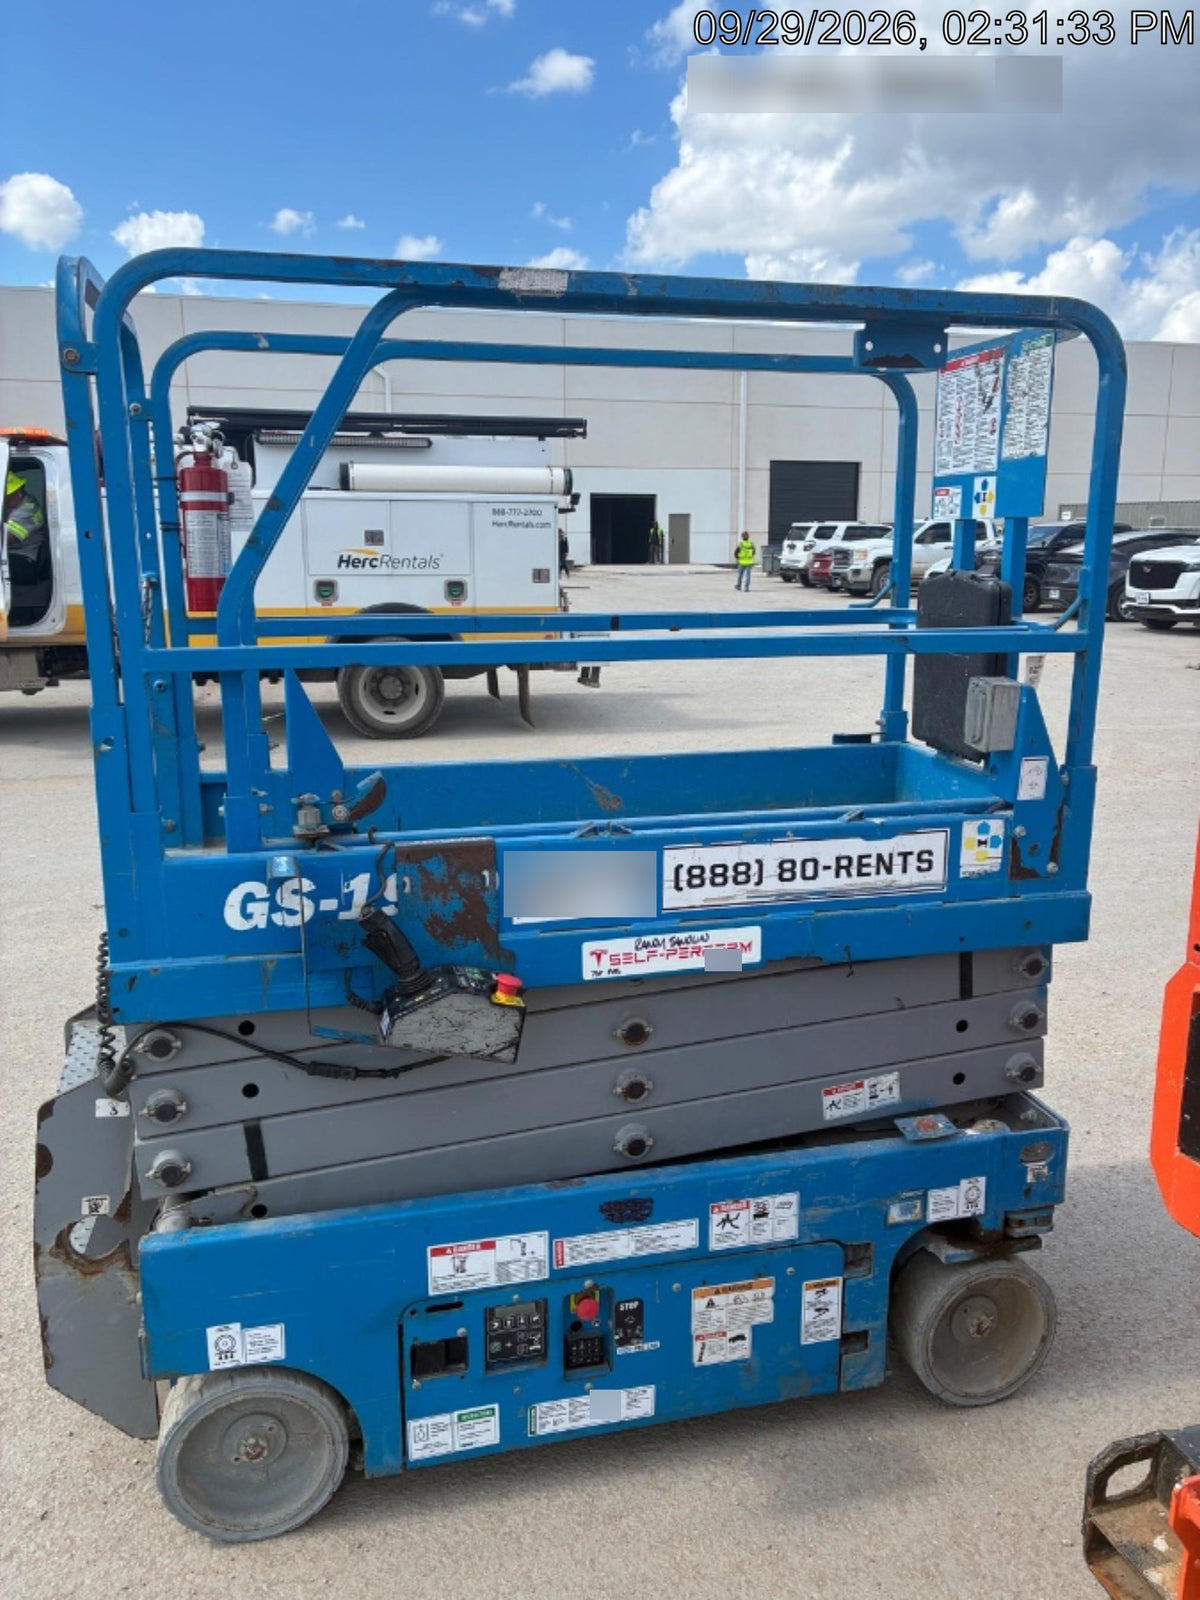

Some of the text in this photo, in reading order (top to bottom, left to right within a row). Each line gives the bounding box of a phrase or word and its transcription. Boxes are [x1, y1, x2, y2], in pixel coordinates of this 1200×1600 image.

[673, 850, 935, 891] (888) 80-RENTS
[620, 1301, 639, 1311] STOP
